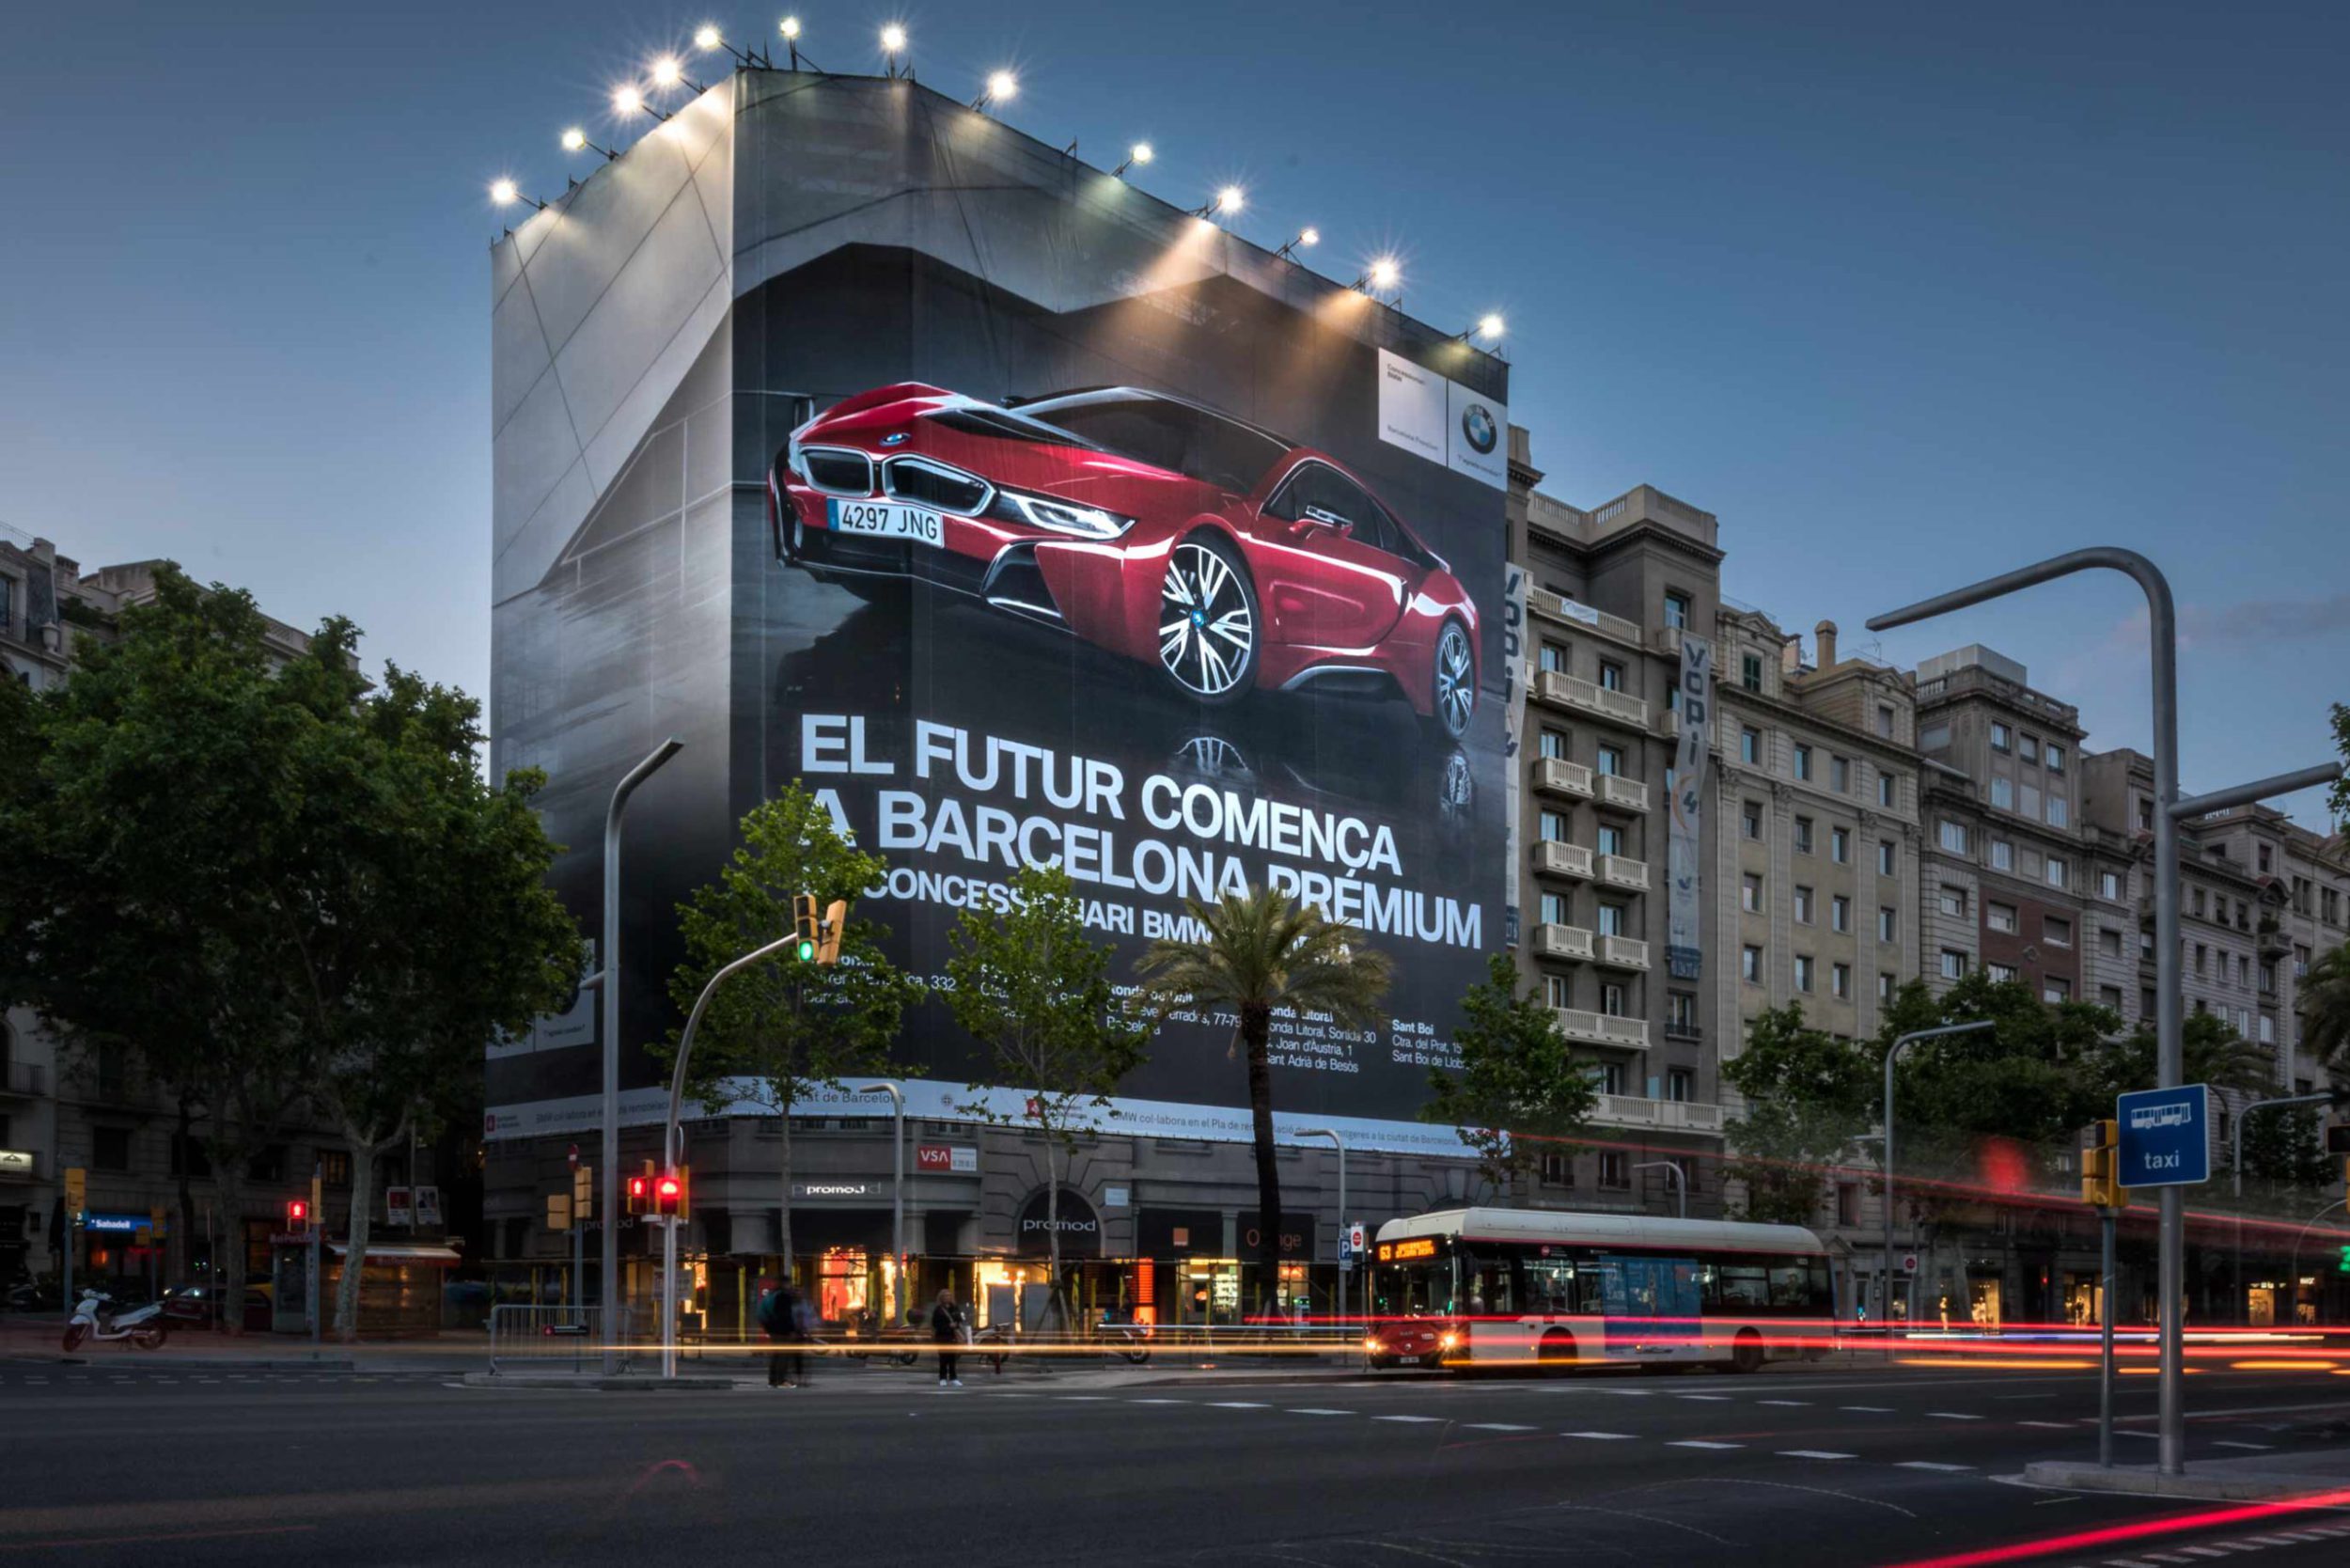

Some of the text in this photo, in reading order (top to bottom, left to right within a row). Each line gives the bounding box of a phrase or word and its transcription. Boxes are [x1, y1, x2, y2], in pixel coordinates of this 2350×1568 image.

[842, 505, 937, 540] 4297 JNG
[802, 713, 1402, 876] EL FUTUR COMENÇA
[878, 790, 1251, 905] BARCELONA
[1268, 863, 1481, 949] PRÉMIUM
[1143, 909, 1213, 946] BMW
[931, 975, 956, 992] 332
[1269, 1021, 1293, 1035] onda
[1363, 1030, 1377, 1044] 30
[1391, 1019, 1434, 1036] Sant Boi
[1276, 1037, 1300, 1052] Joan
[1415, 1038, 1429, 1049] del
[1430, 1039, 1449, 1054] Prat,
[1314, 1057, 1327, 1070] de
[1392, 1049, 1413, 1063] Sant
[1415, 1052, 1430, 1065] Boi
[1431, 1055, 1443, 1067] de
[822, 1091, 838, 1103] de
[1188, 1117, 1200, 1127] en
[1201, 1117, 1210, 1128] el
[1212, 1118, 1226, 1130] Pla
[1228, 1120, 1239, 1131] de
[920, 1149, 948, 1163] VSA
[2144, 1150, 2179, 1169] taxi
[96, 1218, 132, 1230] Sabadell
